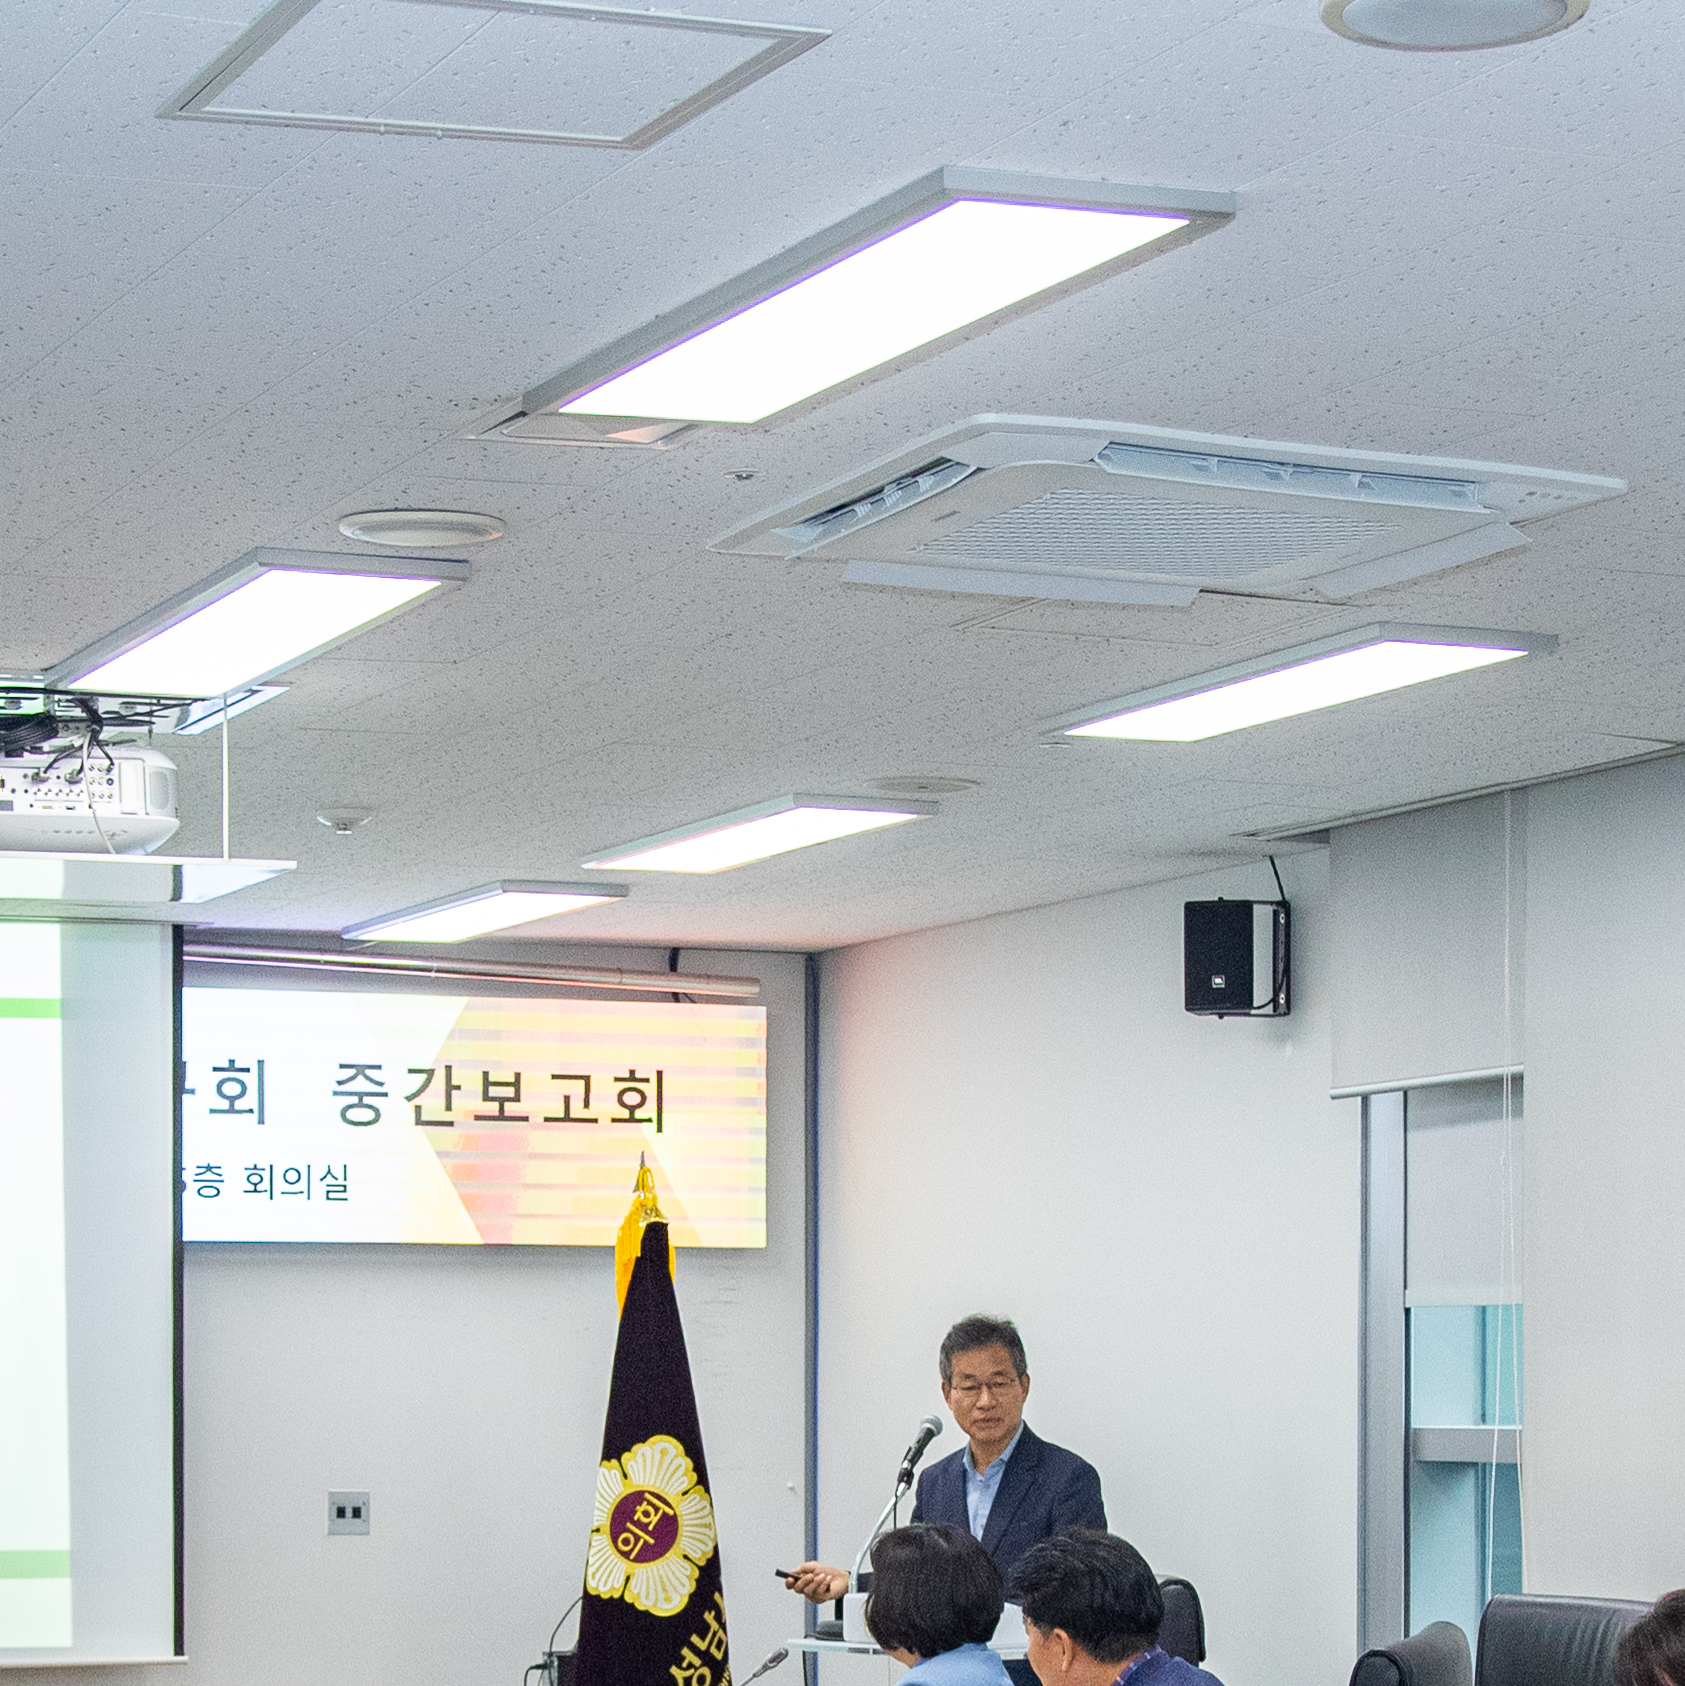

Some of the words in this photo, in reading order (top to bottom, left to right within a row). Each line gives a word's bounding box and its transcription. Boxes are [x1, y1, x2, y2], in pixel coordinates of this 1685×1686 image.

[331, 1062, 664, 1134] 중간보고회
[182, 1163, 225, 1198] 층
[243, 1163, 348, 1201] 회의실
[617, 1492, 675, 1560] 의회
